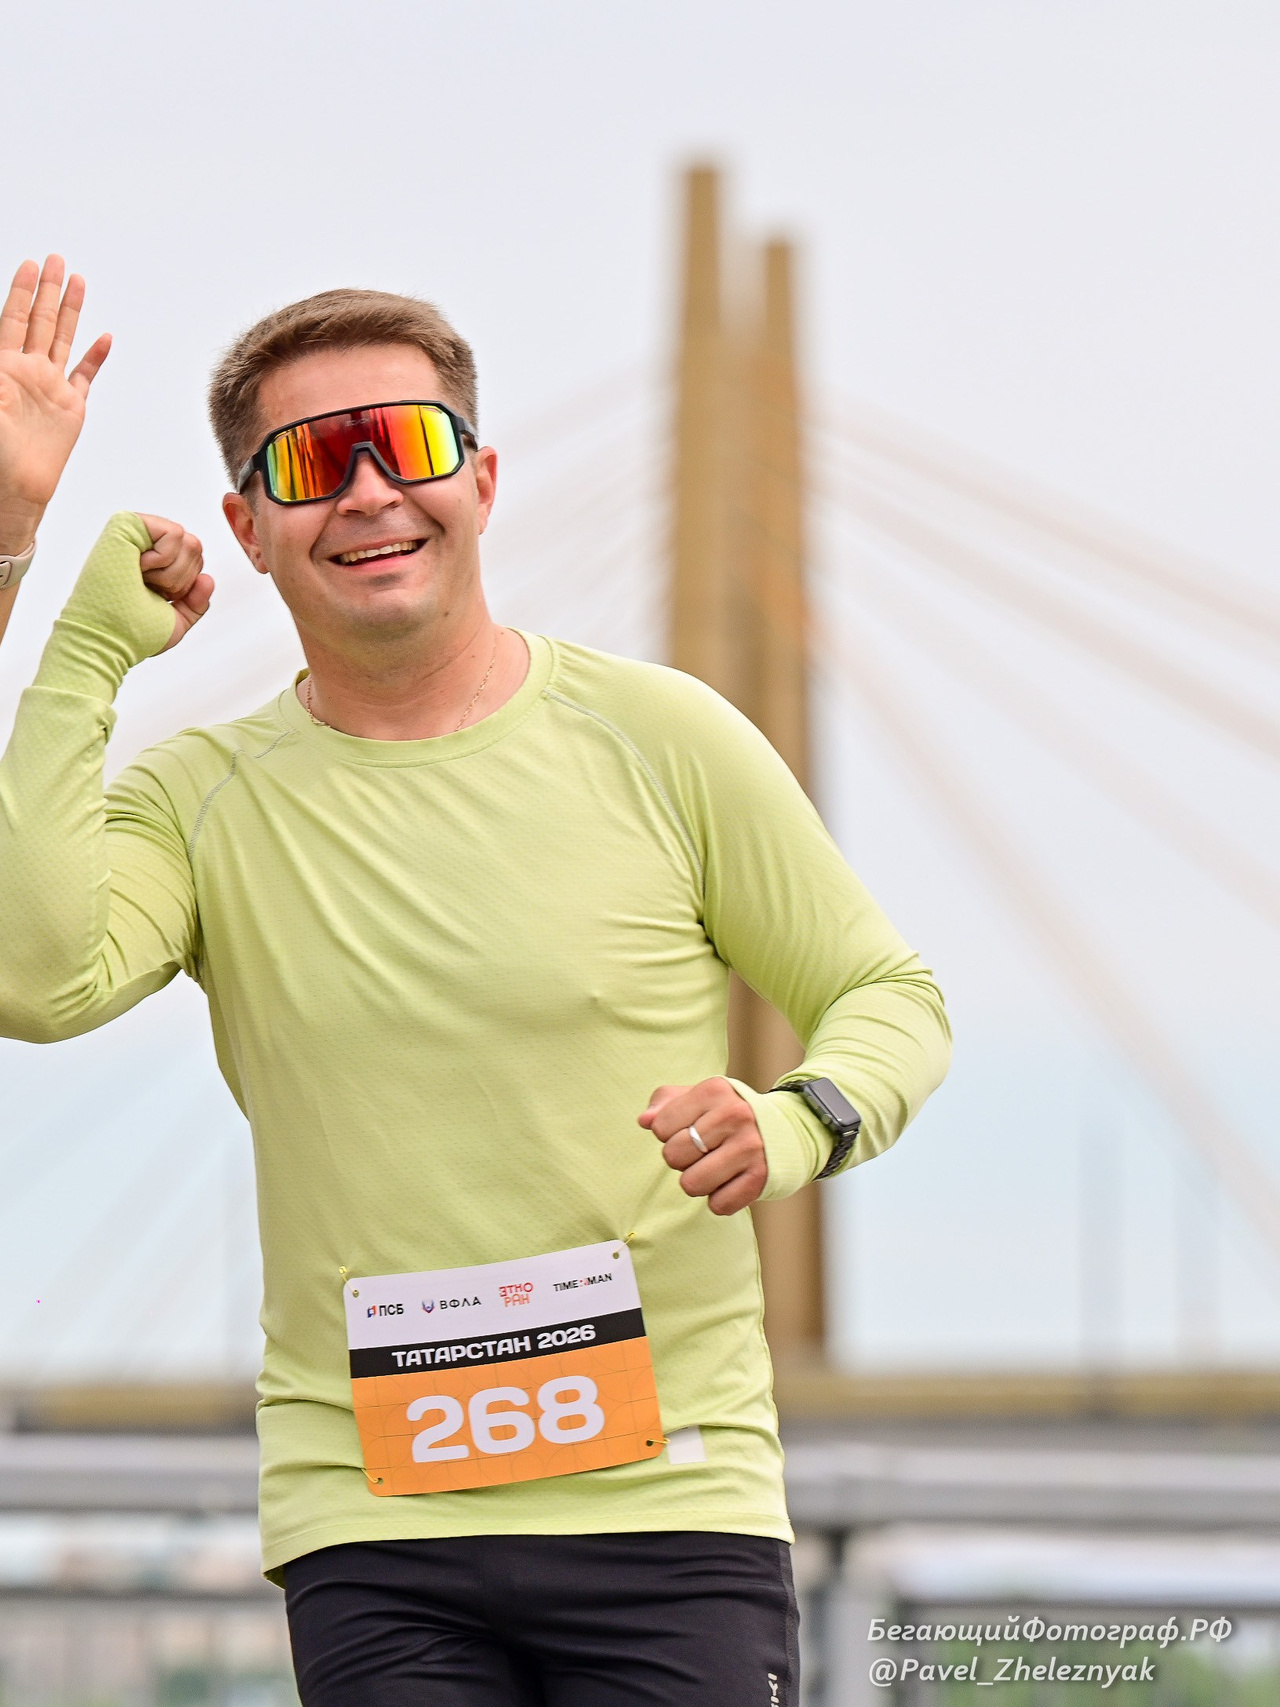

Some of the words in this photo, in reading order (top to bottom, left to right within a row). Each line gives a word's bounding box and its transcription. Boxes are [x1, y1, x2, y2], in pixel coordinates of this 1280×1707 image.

[498, 1282, 533, 1298] ЭТНО
[504, 1293, 530, 1307] РАН
[379, 1303, 404, 1316] ПСБ
[440, 1296, 482, 1309] ВФЛА
[392, 1335, 531, 1367] ТАТАРСТАН
[537, 1324, 596, 1349] 2026
[406, 1375, 605, 1463] 268
